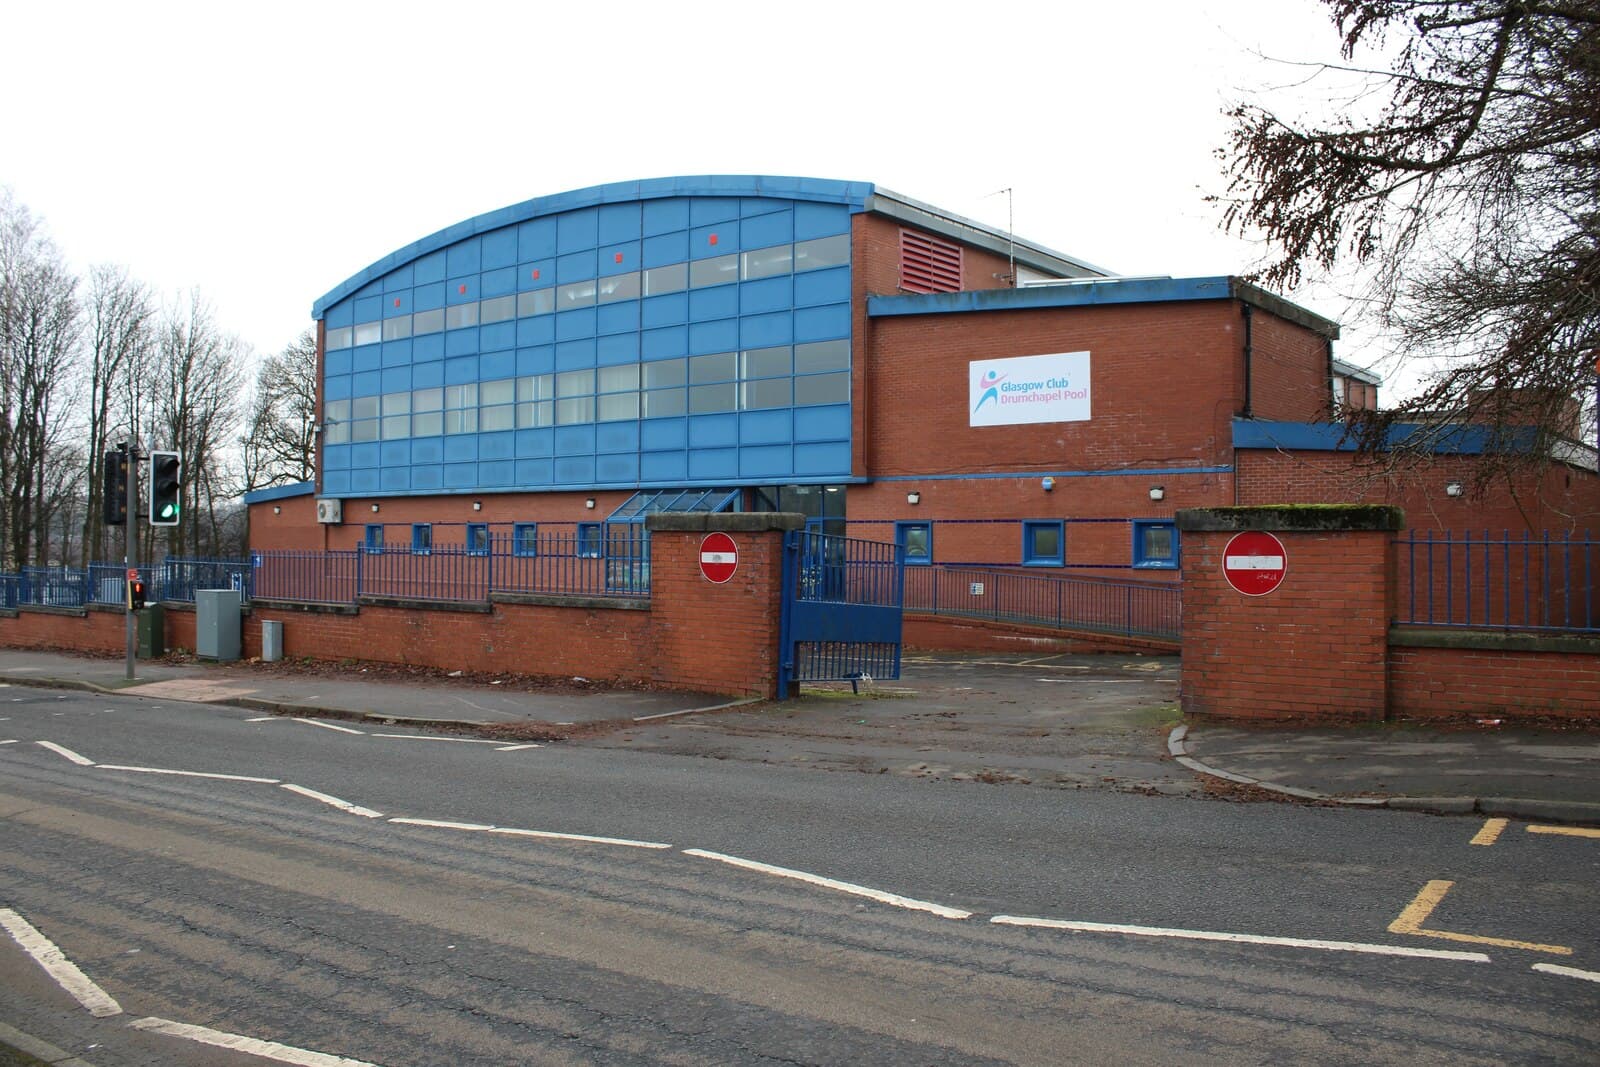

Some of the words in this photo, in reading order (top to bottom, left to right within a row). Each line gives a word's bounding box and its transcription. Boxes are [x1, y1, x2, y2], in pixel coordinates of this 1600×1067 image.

[1001, 381, 1044, 393] Glasgow
[1047, 377, 1069, 389] Club
[1001, 391, 1061, 404] Drumchapel
[1064, 389, 1087, 400] Pool
